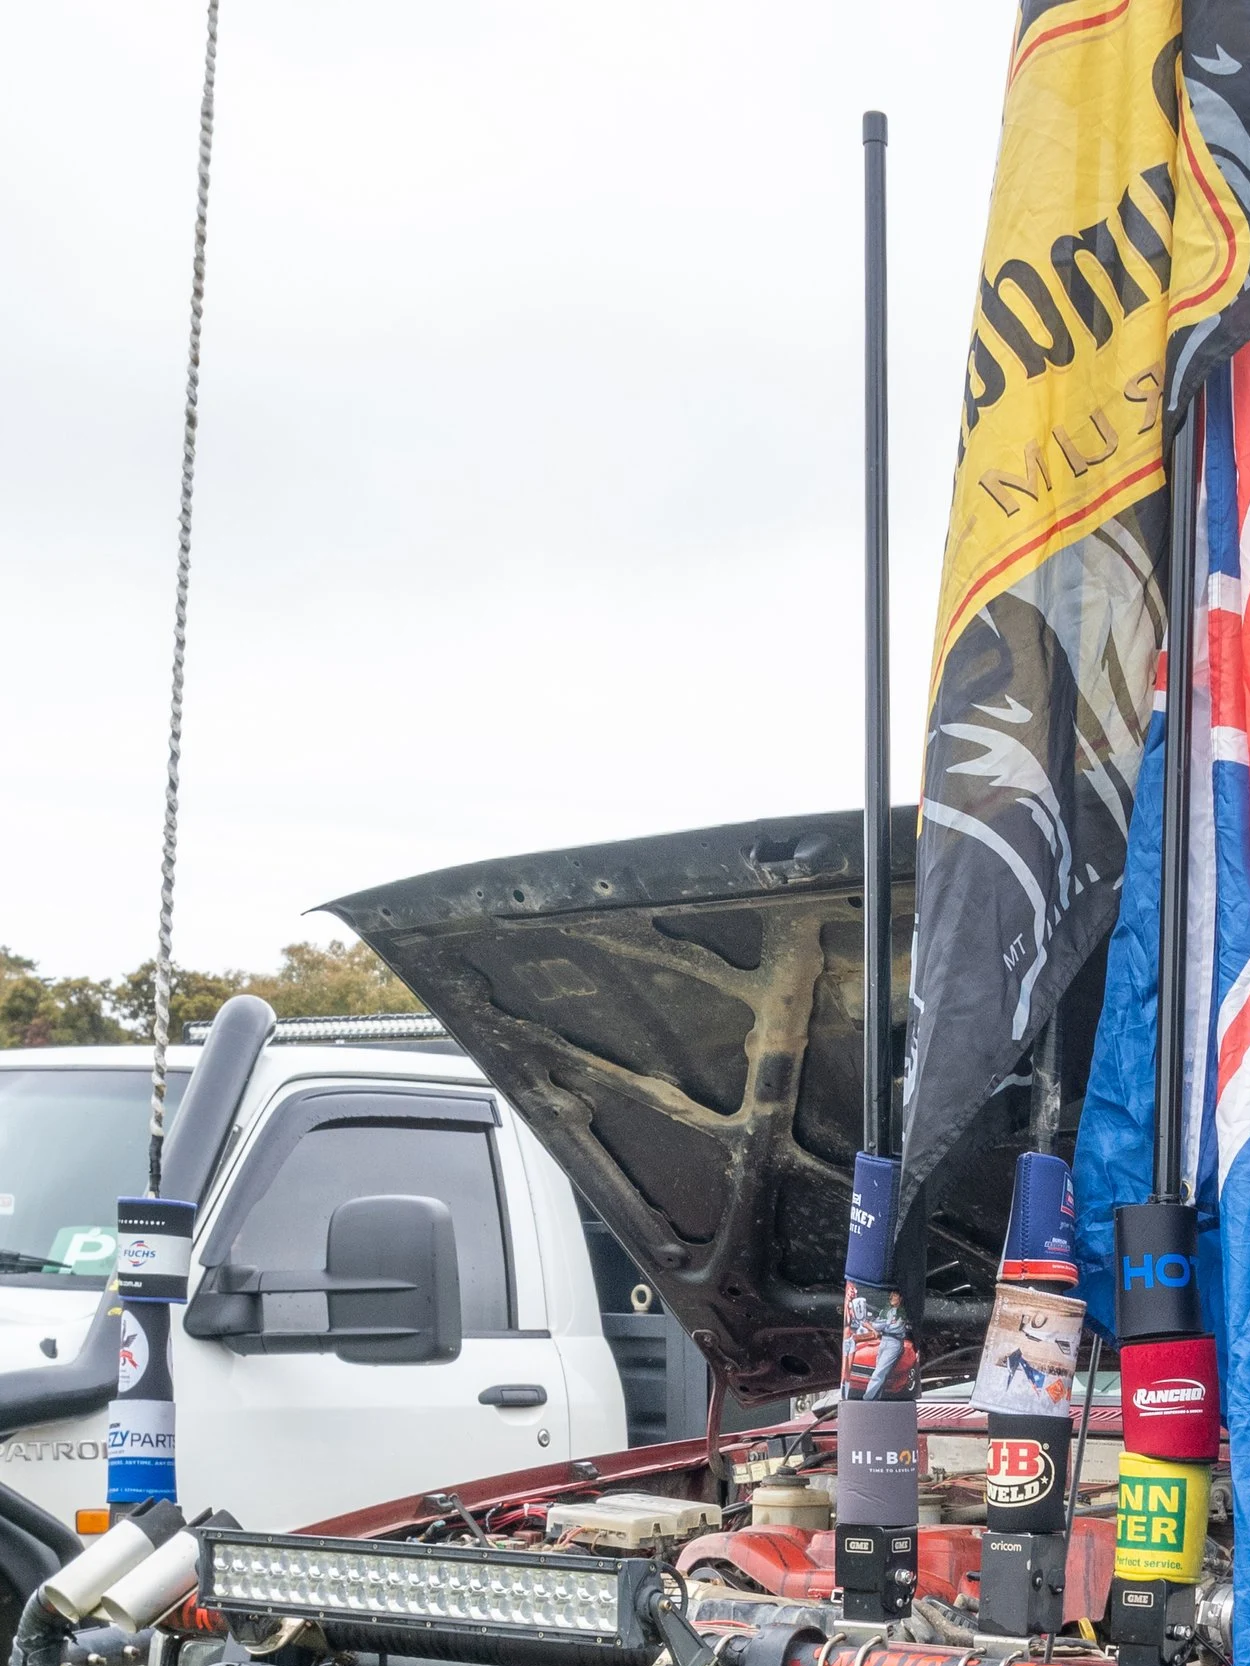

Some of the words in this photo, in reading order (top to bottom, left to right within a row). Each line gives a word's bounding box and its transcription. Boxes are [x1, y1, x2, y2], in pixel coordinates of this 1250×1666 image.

[850, 1206, 875, 1228] RKET
[123, 1249, 157, 1258] FUCHS
[1136, 1387, 1204, 1405] RANCHO
[852, 1450, 918, 1466] HI-BOL
[987, 1441, 1040, 1477] J-B
[987, 1481, 1040, 1503] WELD
[1119, 1483, 1180, 1513] NN
[849, 1541, 870, 1551] GME
[894, 1540, 909, 1550] GME
[990, 1541, 1023, 1552] oricom
[1143, 1559, 1184, 1571] service.
[1126, 1593, 1150, 1605] GME
